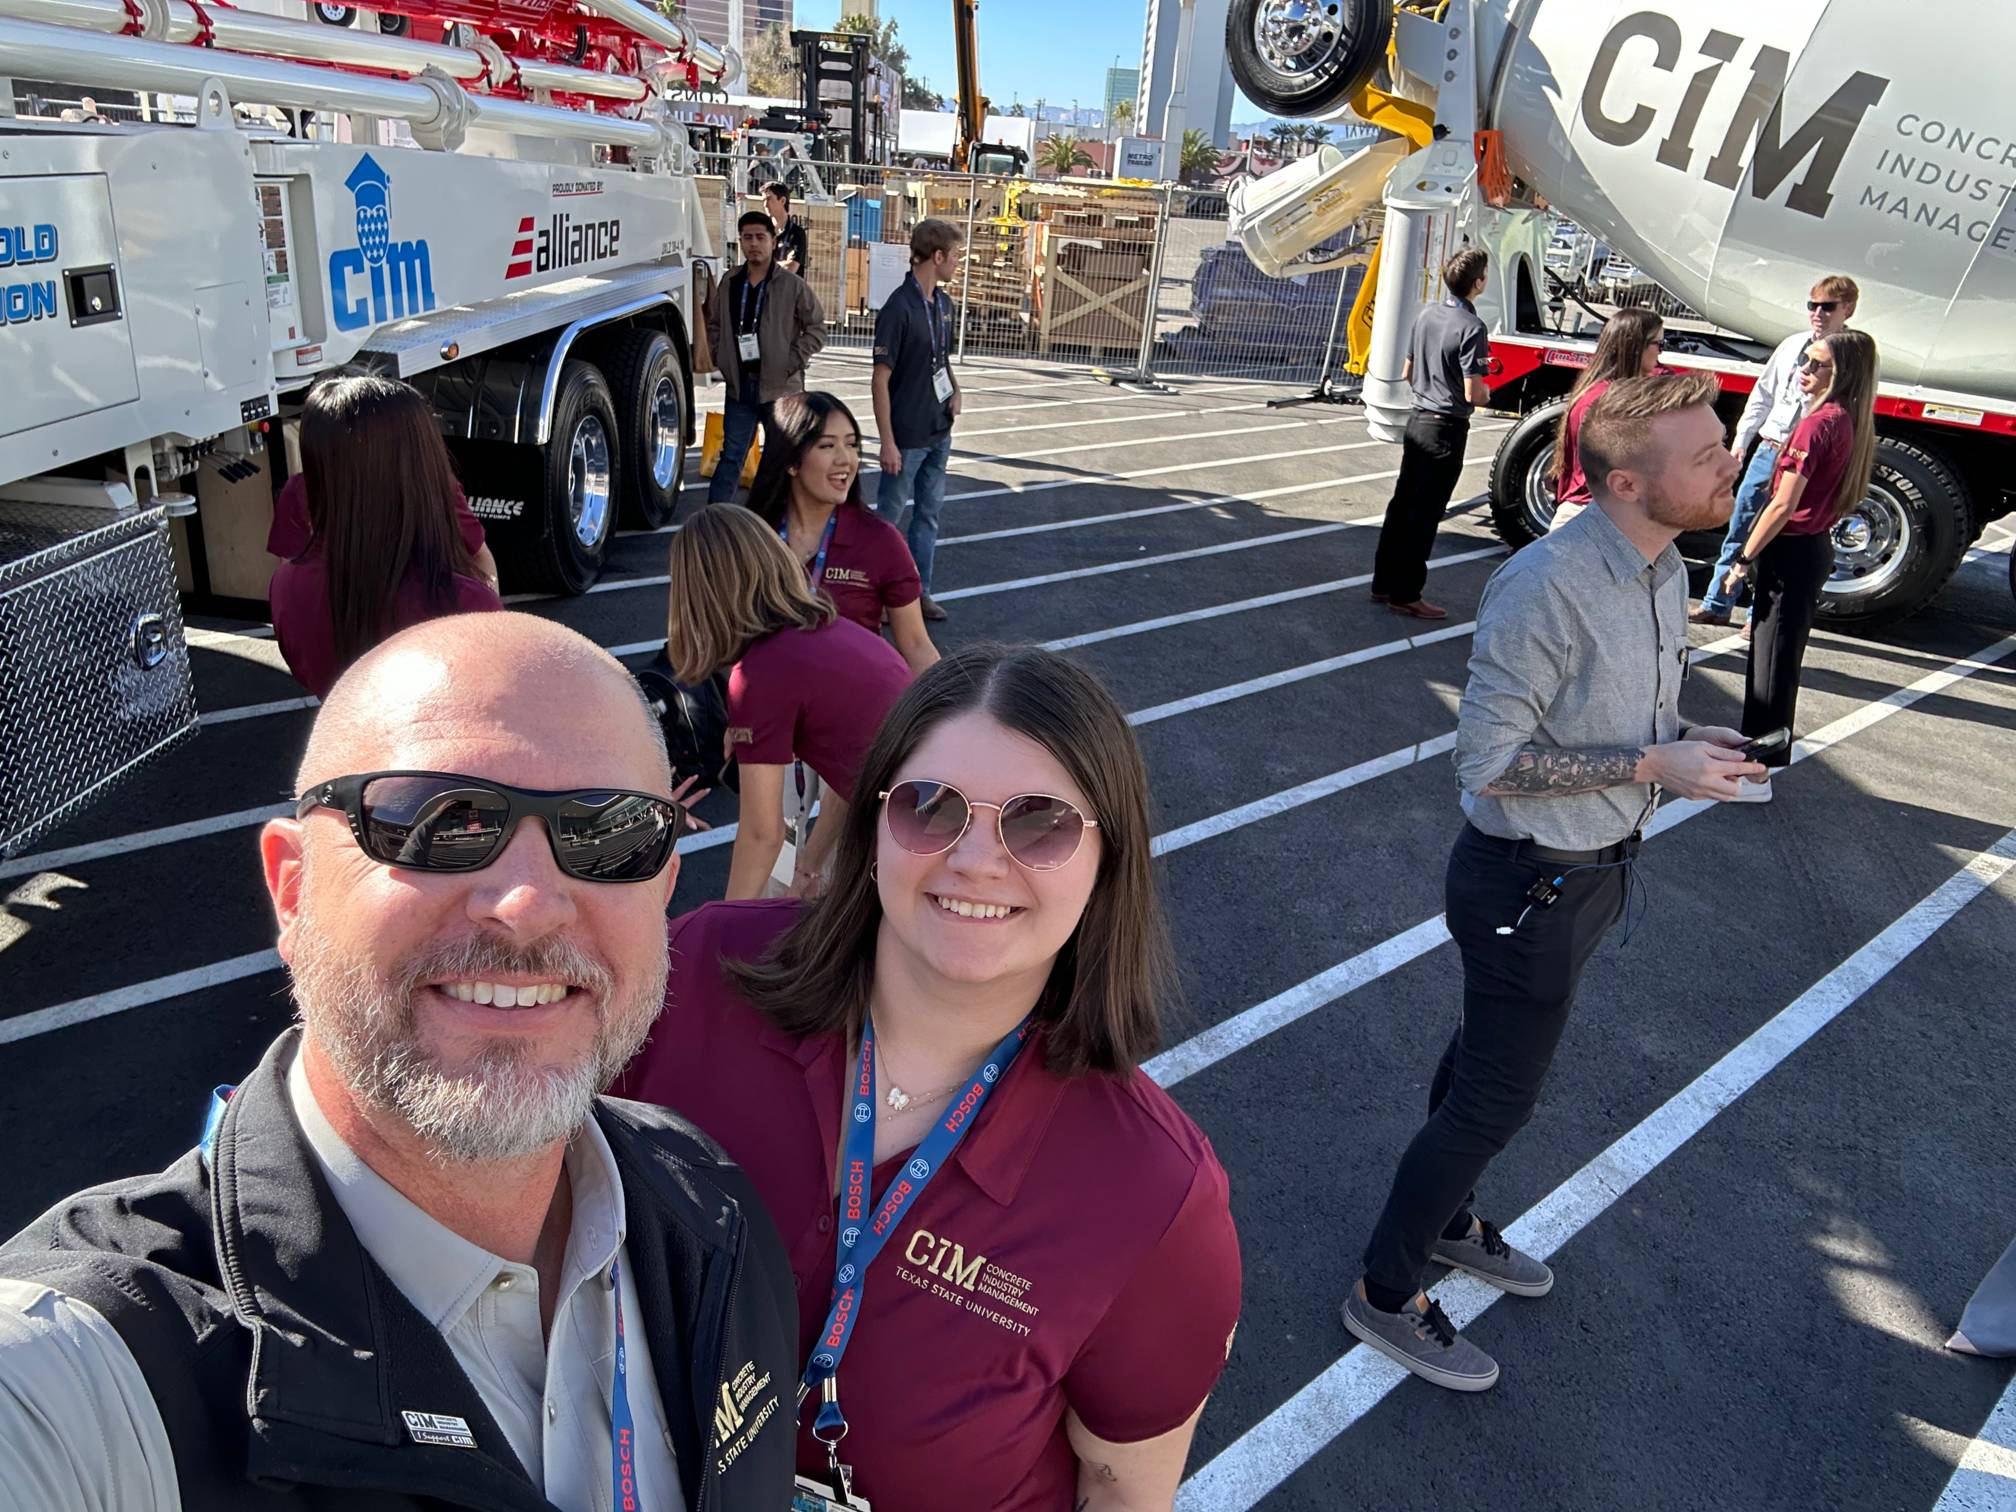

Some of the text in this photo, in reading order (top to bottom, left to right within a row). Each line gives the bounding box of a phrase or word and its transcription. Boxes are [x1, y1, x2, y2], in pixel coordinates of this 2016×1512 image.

[552, 183, 574, 193] PROUDLY
[1876, 148, 2016, 210] INDUST
[536, 213, 620, 273] alliance
[1859, 185, 2016, 254] MANAGE
[1872, 464, 1928, 510] STONE
[825, 567, 850, 580] CIM
[859, 1040, 872, 1096] BOSCH
[945, 1083, 985, 1133] BOSCH
[847, 1160, 864, 1219] BOSCH
[873, 1180, 912, 1235] BOSCH
[896, 1265, 1031, 1337] TEXAS STATE UNIVERSITY
[977, 1282, 1040, 1317] MANAGEMENT
[982, 1272, 1025, 1299] INDUSTRY
[986, 1263, 1033, 1292] CONCRETE
[405, 1412, 438, 1429] CIM
[725, 1436, 749, 1466] STATE
[746, 1395, 780, 1442] UNIVERSITY
[619, 1428, 636, 1512] BOSCH
